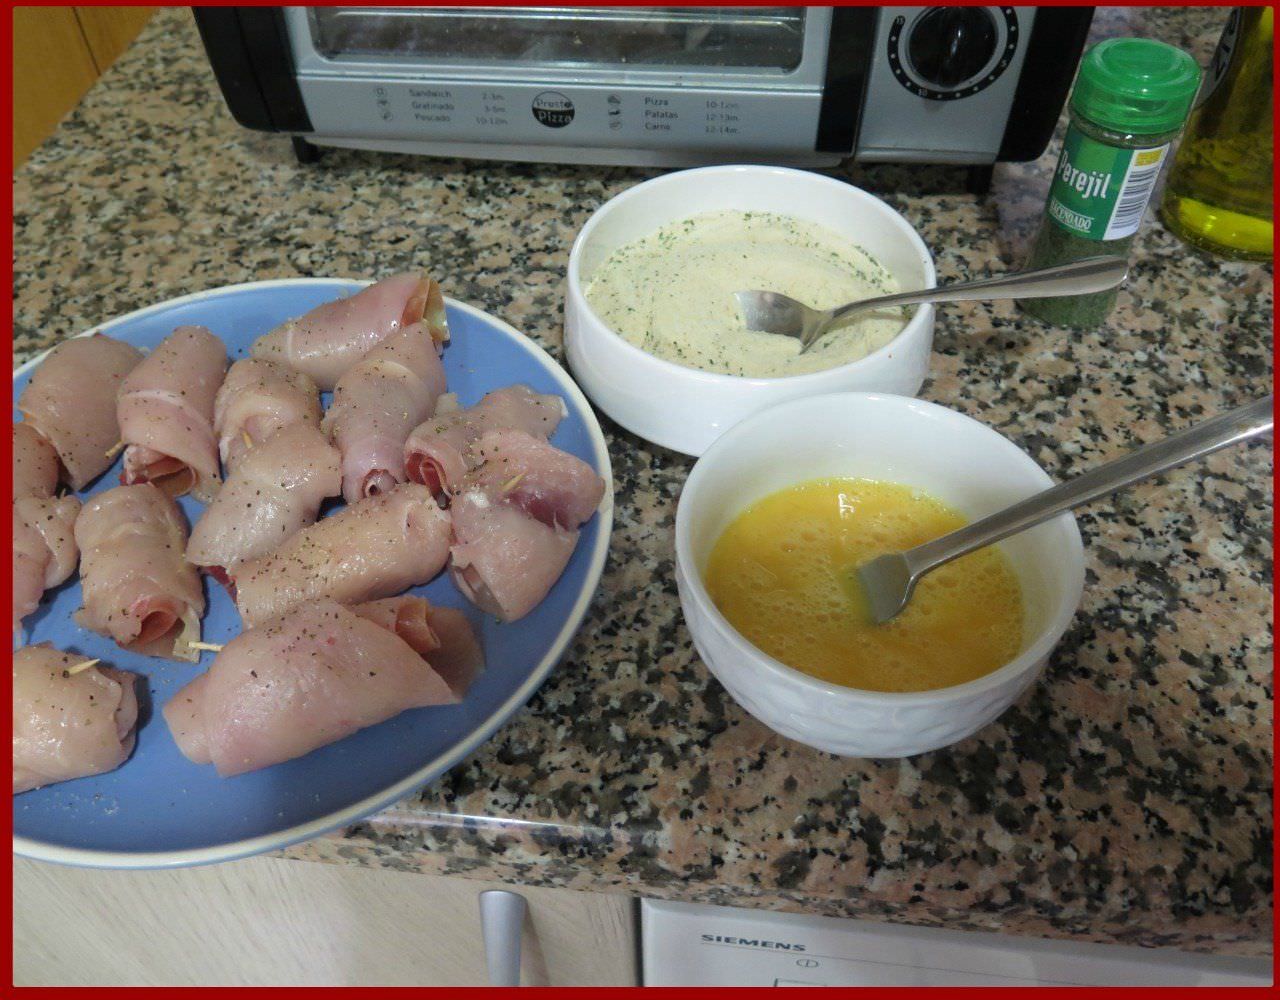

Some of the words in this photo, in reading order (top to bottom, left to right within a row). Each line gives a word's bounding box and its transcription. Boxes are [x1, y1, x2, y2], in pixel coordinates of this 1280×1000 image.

[409, 88, 452, 98] Sandwich
[411, 100, 455, 111] Gratinado
[645, 96, 669, 106] Pizza
[645, 109, 679, 119] Patatas
[1059, 150, 1112, 199] Perejil
[701, 934, 806, 952] SIEMENS
